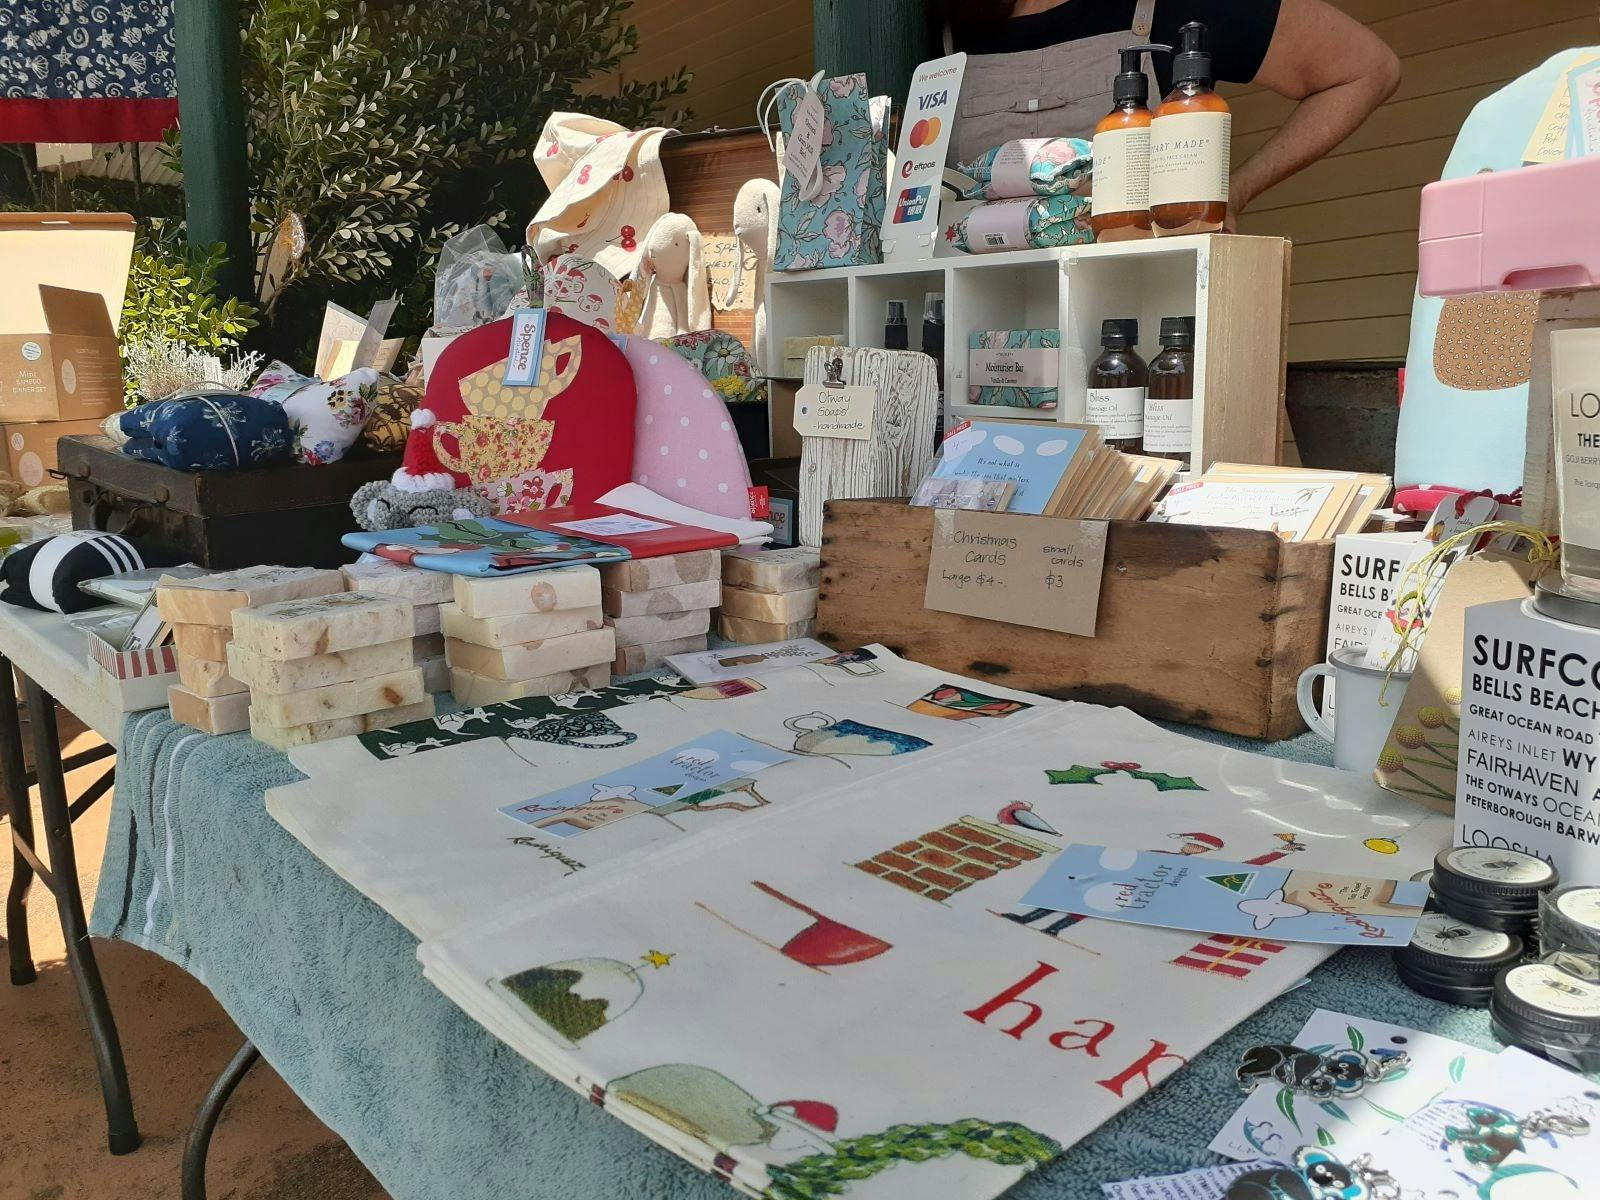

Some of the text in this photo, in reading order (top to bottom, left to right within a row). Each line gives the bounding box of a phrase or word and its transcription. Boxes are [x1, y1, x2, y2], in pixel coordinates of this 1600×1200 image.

[919, 67, 958, 82] We welcome
[918, 90, 948, 110] VISA
[914, 161, 936, 171] eftpos
[899, 195, 928, 208] UnionPay
[518, 324, 536, 370] Spence
[986, 362, 1024, 372] Moisturiser Bar
[818, 390, 851, 410] Otway
[1089, 390, 1110, 402] Bliss
[1570, 392, 1600, 418] LO
[1108, 404, 1118, 412] Oil
[1578, 433, 1600, 448] THE
[998, 458, 1014, 468] what
[954, 530, 1017, 550] Christmas
[1042, 544, 1074, 554] small
[966, 550, 1006, 565] Cards
[1051, 556, 1084, 568] cards
[1340, 554, 1400, 582] SURF
[942, 570, 972, 589] Large
[1044, 570, 1064, 589] $3
[1340, 582, 1376, 600] BELLS
[1337, 604, 1383, 620] GREAT OCE
[1336, 623, 1368, 636] AIREYS
[1472, 673, 1522, 702] BELLS
[1530, 686, 1600, 720] BEACH
[1469, 704, 1594, 745] GREAT OCEAN ROAD
[1468, 728, 1598, 774] AIREYS INLET WY
[670, 756, 720, 778] tractor
[1467, 748, 1579, 797] FAIRHAVEN
[1466, 774, 1600, 826] THE OTWAYS OCEA
[1466, 794, 1600, 846] PETERBOROUGH BARW
[1112, 882, 1139, 902] red
[1116, 864, 1172, 909] tractor
